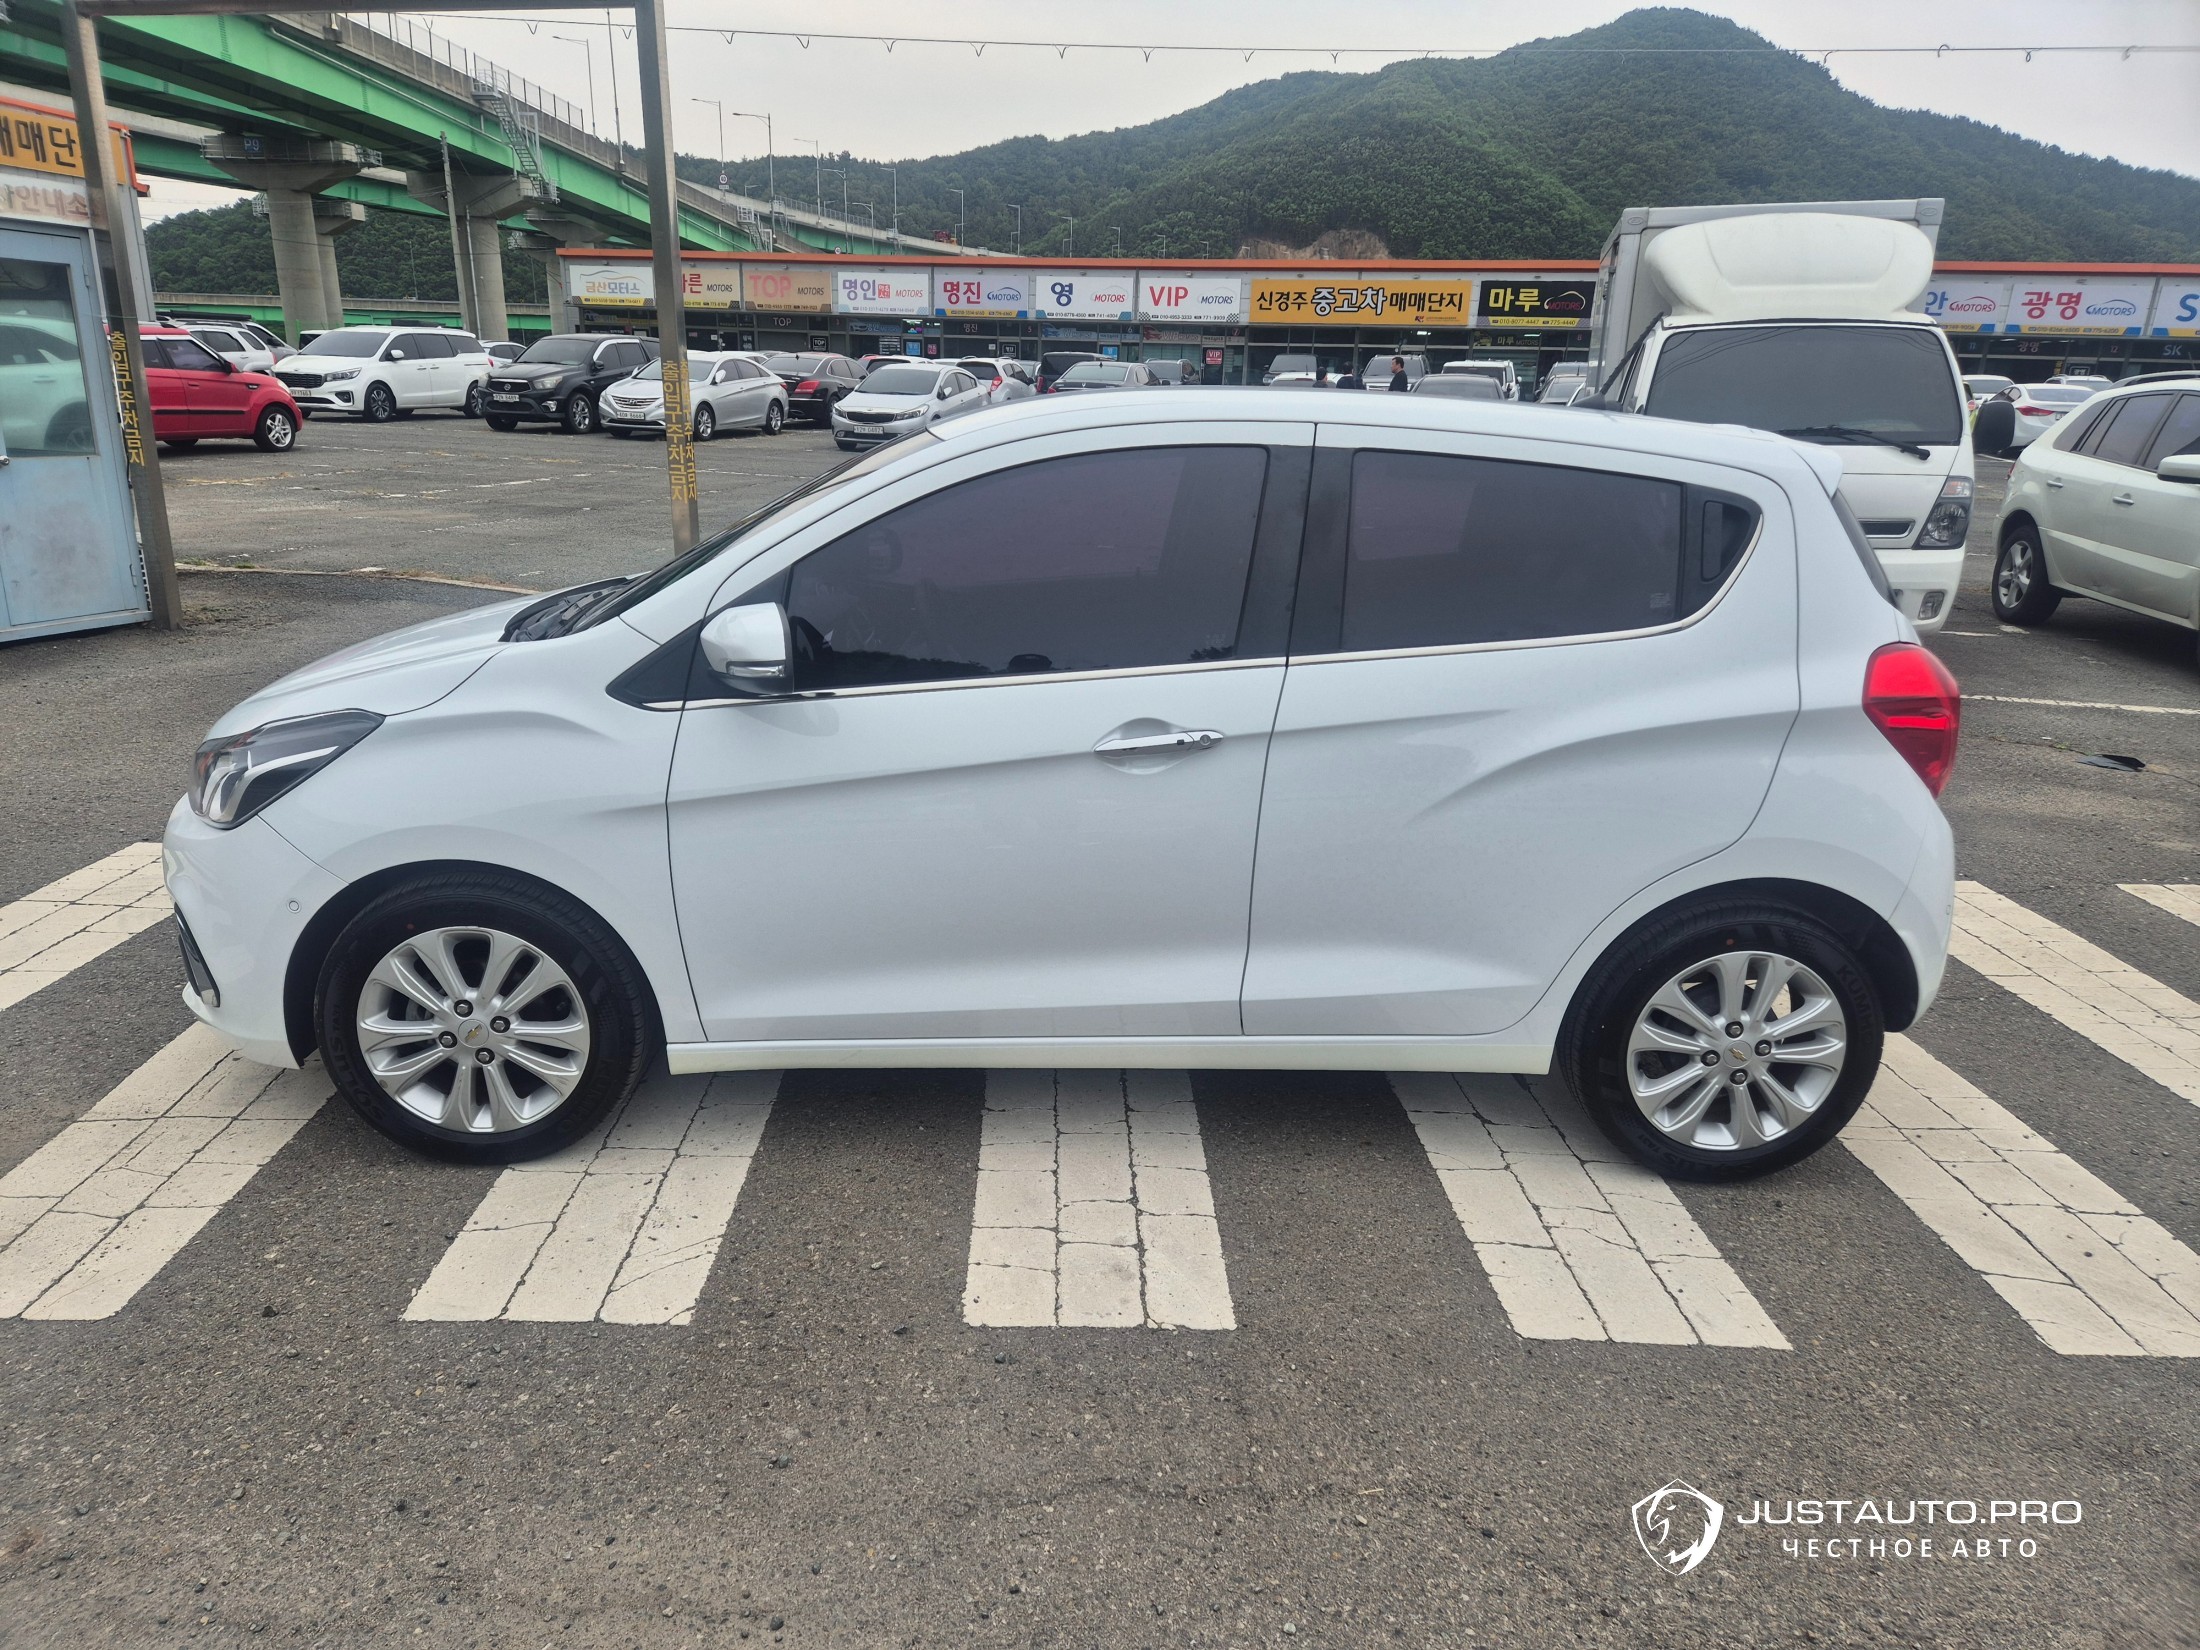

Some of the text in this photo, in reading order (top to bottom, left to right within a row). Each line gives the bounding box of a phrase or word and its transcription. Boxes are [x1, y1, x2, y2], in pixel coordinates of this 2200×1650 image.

[585, 281, 641, 295] 금산모터스
[749, 275, 824, 298] TOP MOTORS
[842, 279, 876, 300] 명인
[895, 289, 923, 298] MOTORS
[943, 281, 1019, 304] 명진 MOTORS
[1051, 282, 1126, 307] 영 MOTORS
[1149, 286, 1234, 307] VIP MOTORS
[1256, 287, 1463, 316] 신경주 중고차 매매단지
[1488, 287, 1581, 312] 마루 MOTORS
[1953, 304, 1993, 312] MOTORS
[2021, 291, 2133, 320] 광명 MOTORS
[773, 316, 792, 327] TOP
[963, 323, 978, 333] 명진
[1497, 337, 1515, 346] 마루
[2018, 342, 2040, 353] 광명
[2163, 344, 2183, 356] SK
[1208, 350, 1221, 358] VIP
[110, 331, 145, 467] 출입구주차금지
[662, 360, 689, 504] 출입구주차금지
